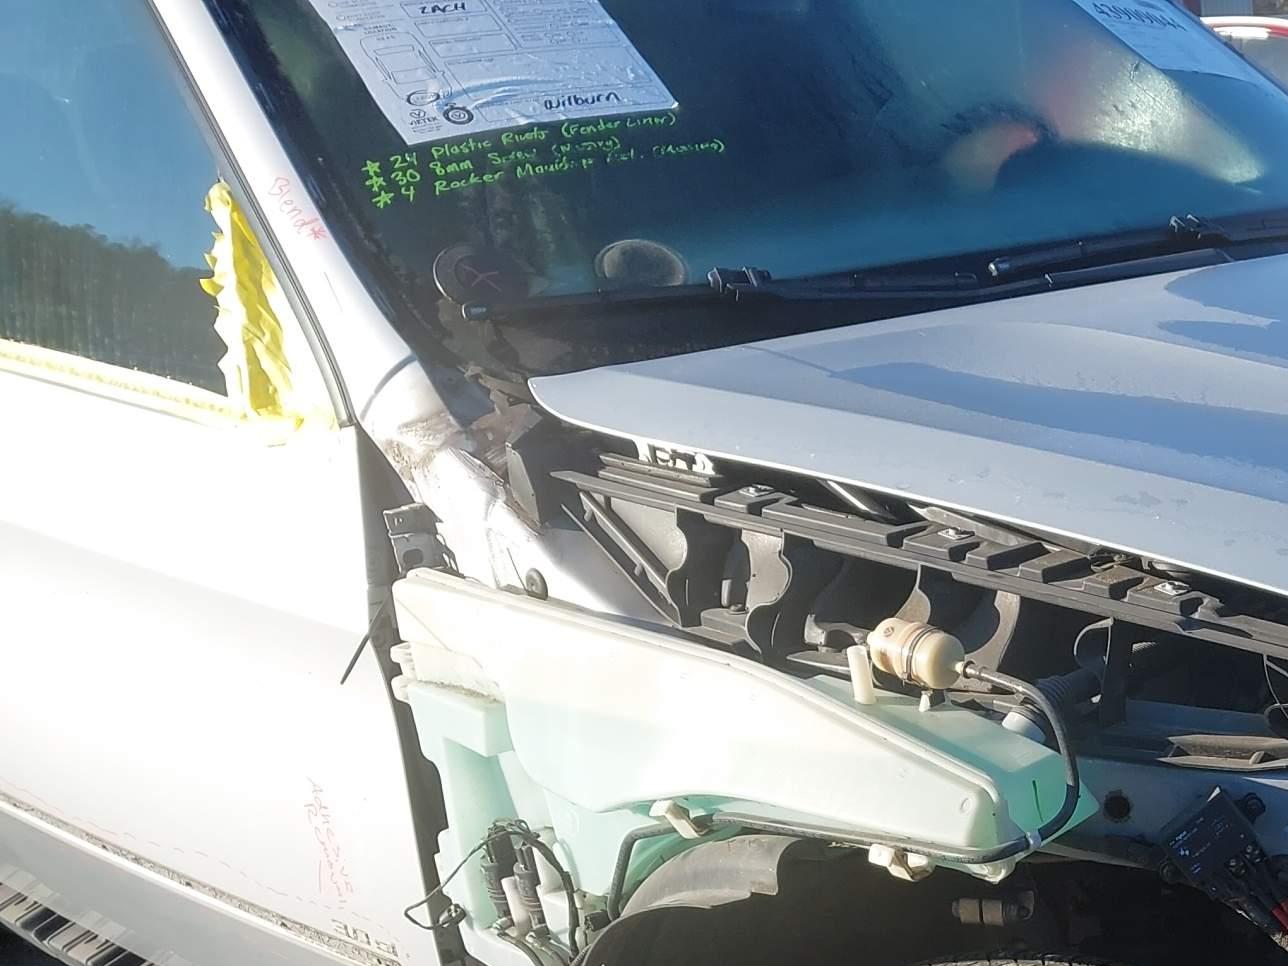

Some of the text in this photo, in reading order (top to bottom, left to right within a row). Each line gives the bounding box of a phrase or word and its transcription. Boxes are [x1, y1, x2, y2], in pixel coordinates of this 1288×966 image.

[420, 2, 466, 15] ZACH
[390, 152, 418, 169] 24
[391, 169, 421, 185] 30
[429, 160, 474, 176] 8mm
[401, 186, 415, 202] 4
[433, 171, 504, 195] Rocker
